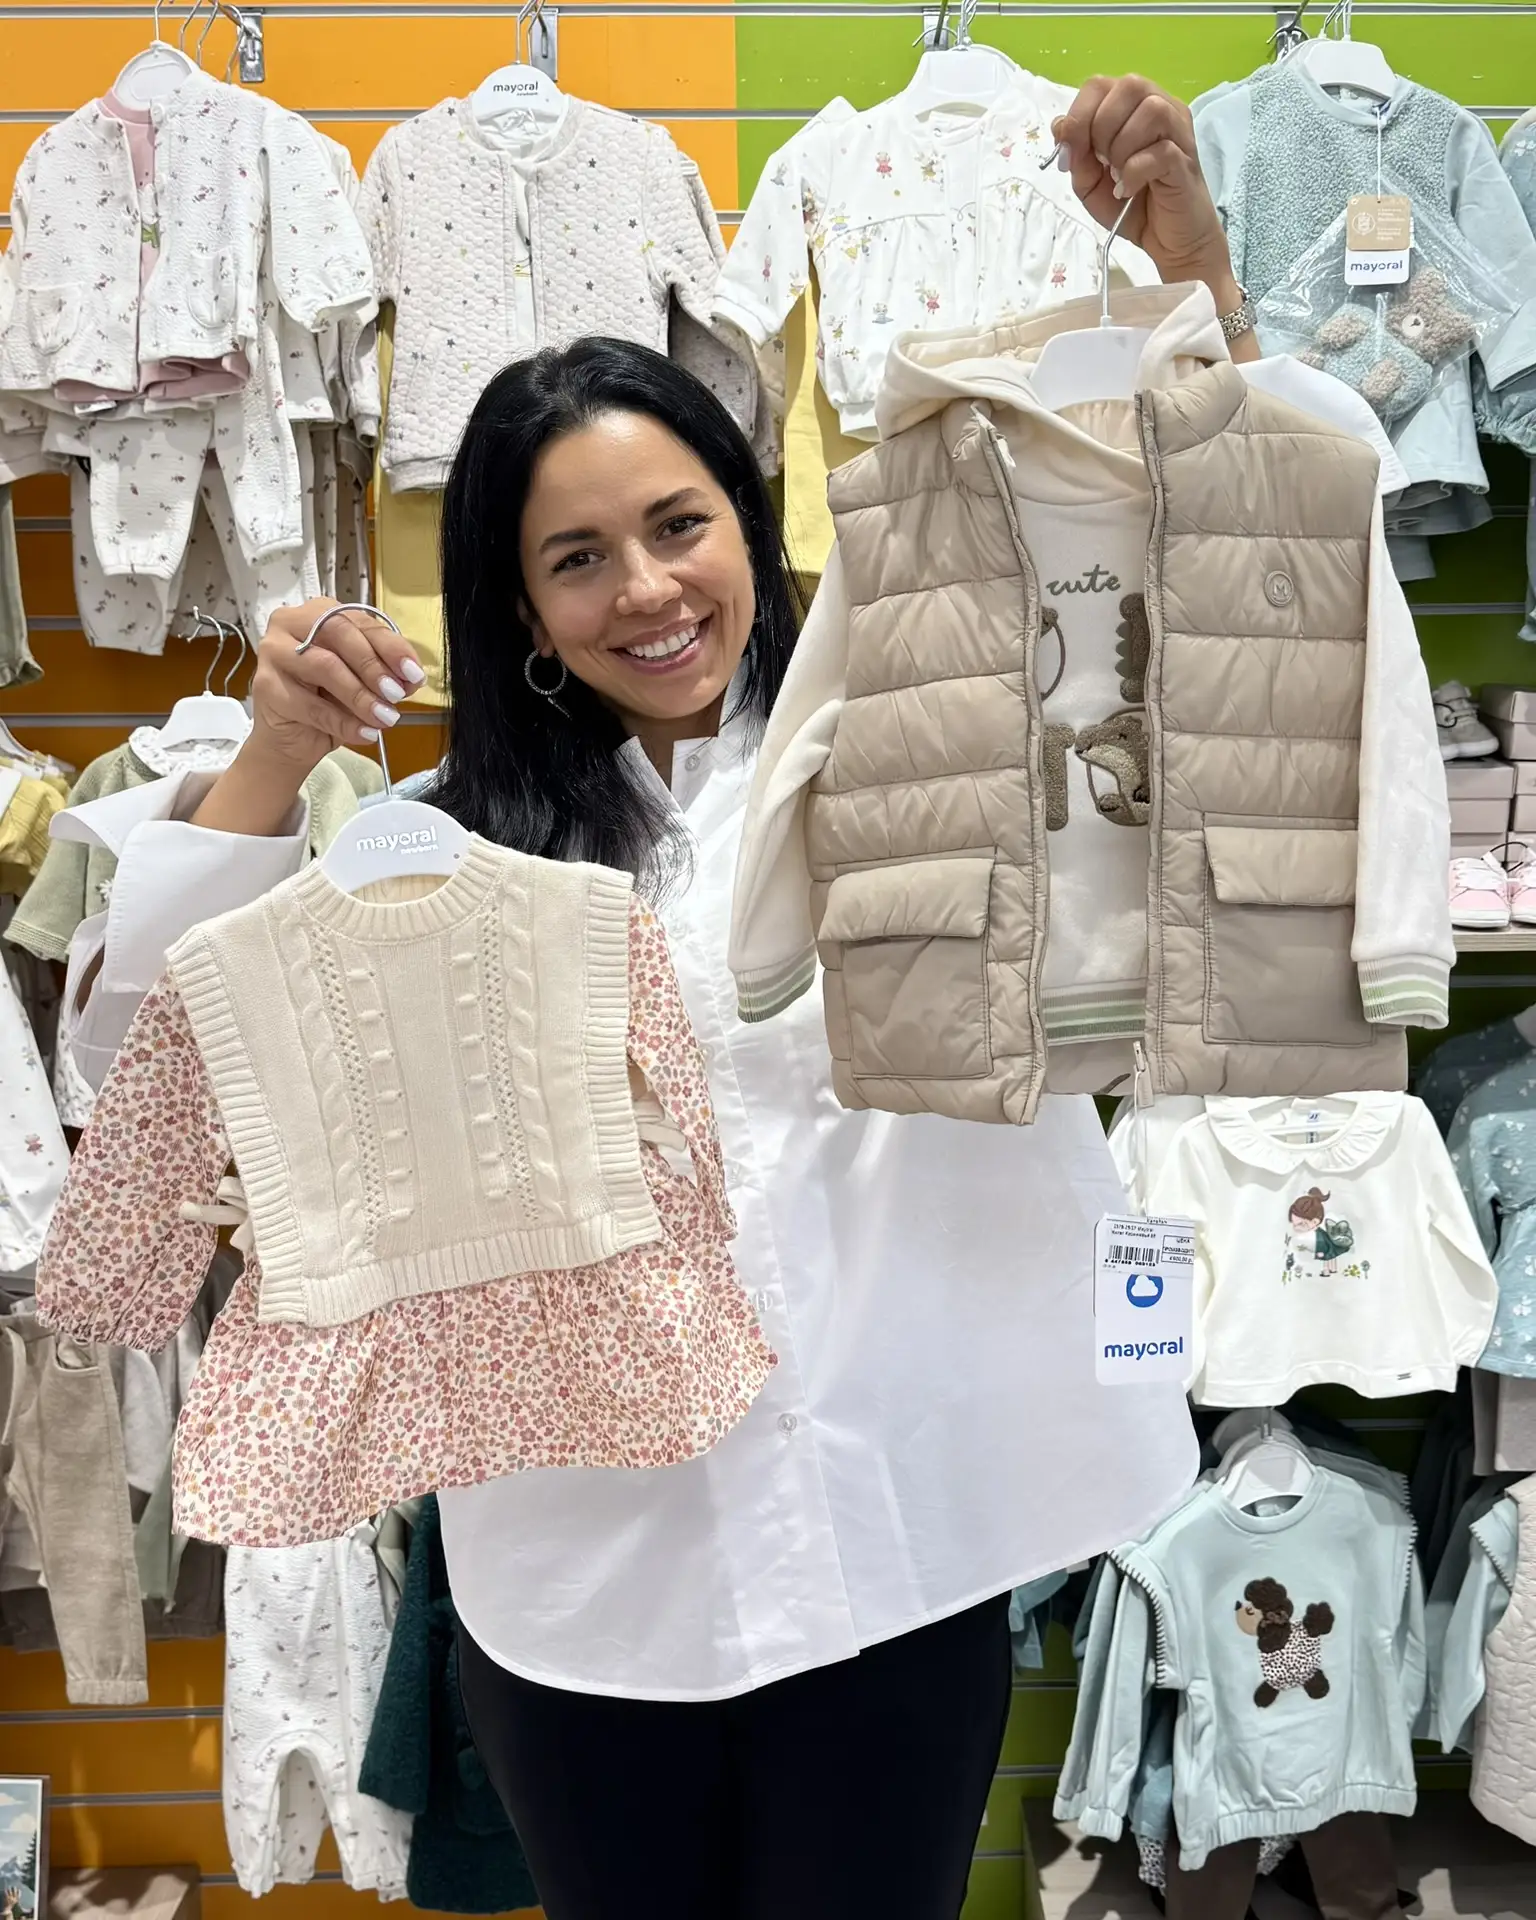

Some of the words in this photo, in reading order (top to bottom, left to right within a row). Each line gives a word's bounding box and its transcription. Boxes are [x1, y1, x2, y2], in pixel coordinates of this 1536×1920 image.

[493, 80, 539, 93] mayoral
[1350, 260, 1403, 272] mayoral
[1046, 563, 1121, 596] cute
[356, 825, 437, 852] mayoral
[400, 843, 439, 855] newborn
[1104, 1336, 1184, 1361] mayoral
